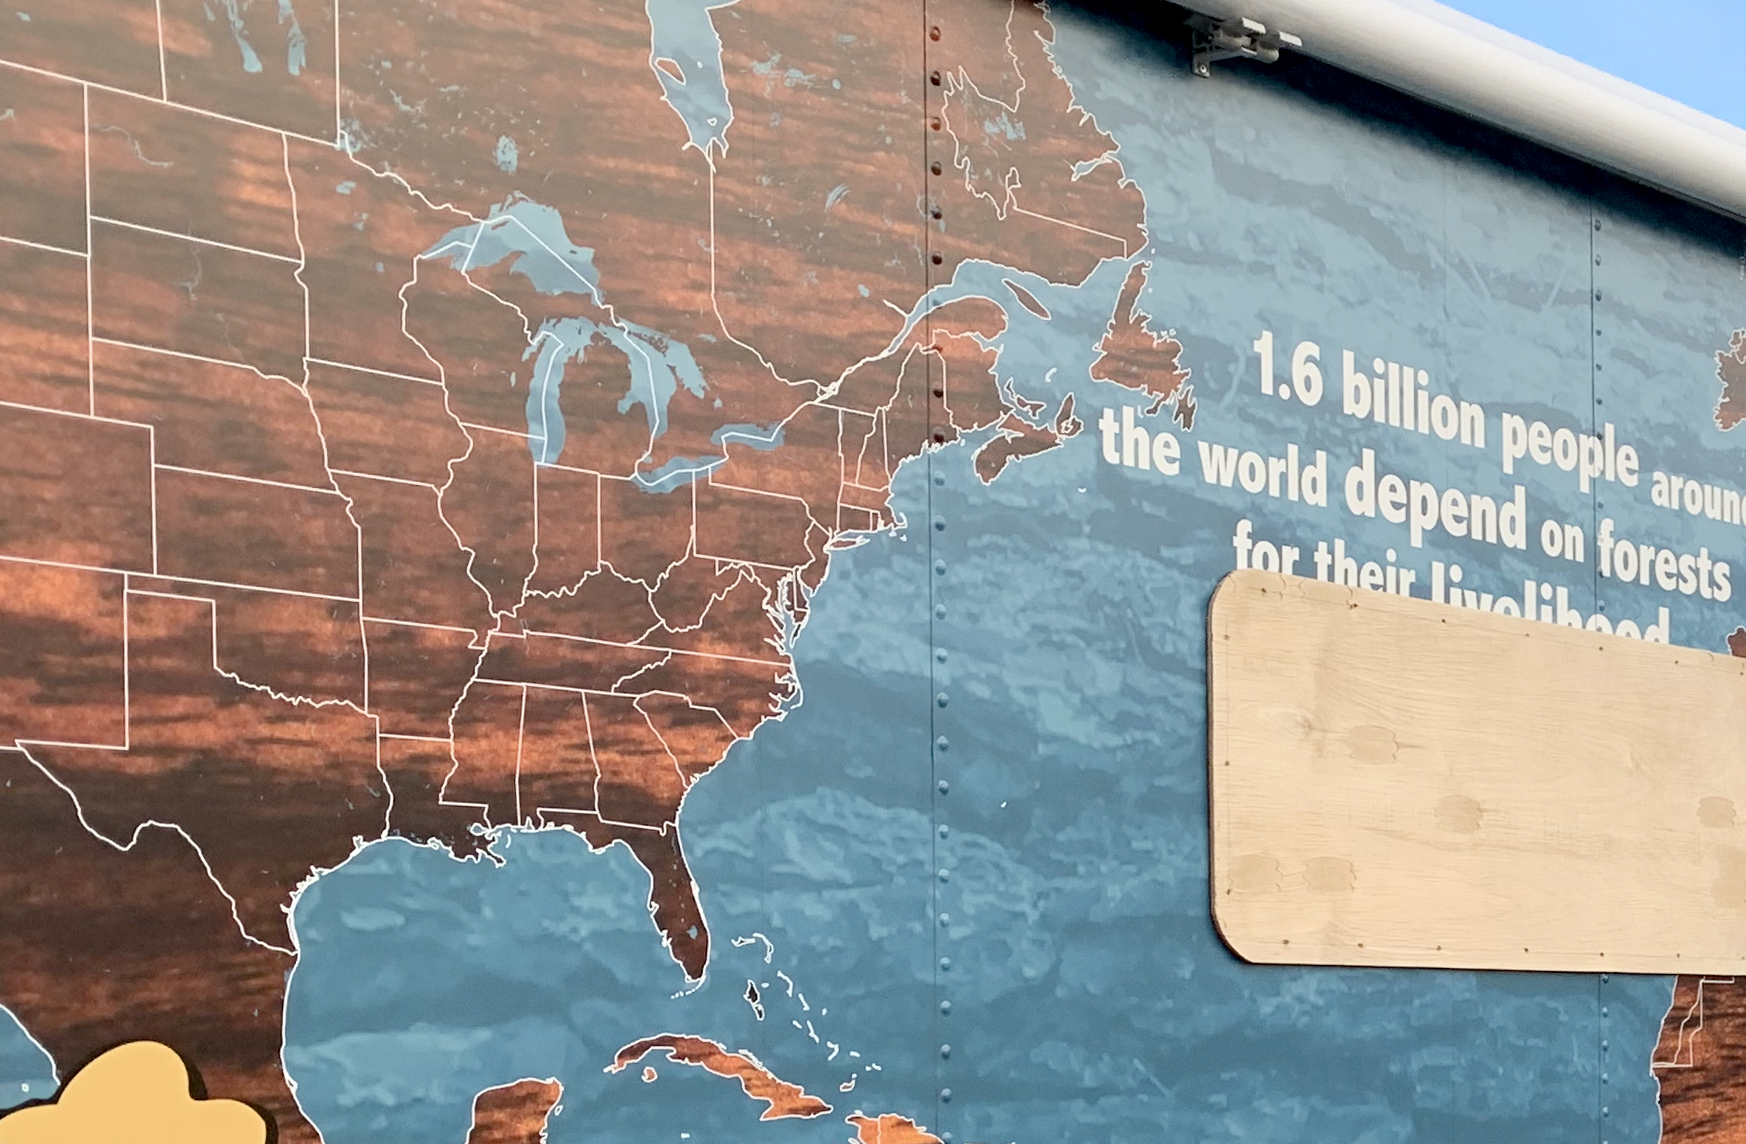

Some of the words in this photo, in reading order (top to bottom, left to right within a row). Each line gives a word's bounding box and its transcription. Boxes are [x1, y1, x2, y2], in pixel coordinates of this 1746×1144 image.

[1253, 330, 1324, 407] 1.6
[1342, 348, 1486, 449] billion
[1501, 412, 1640, 495] people
[1098, 407, 1181, 477] the
[1198, 441, 1328, 508] world
[1344, 448, 1527, 551] depend
[1540, 519, 1585, 563] on
[1597, 517, 1732, 602] forests
[1232, 518, 1300, 575] for
[1313, 538, 1416, 597] their
